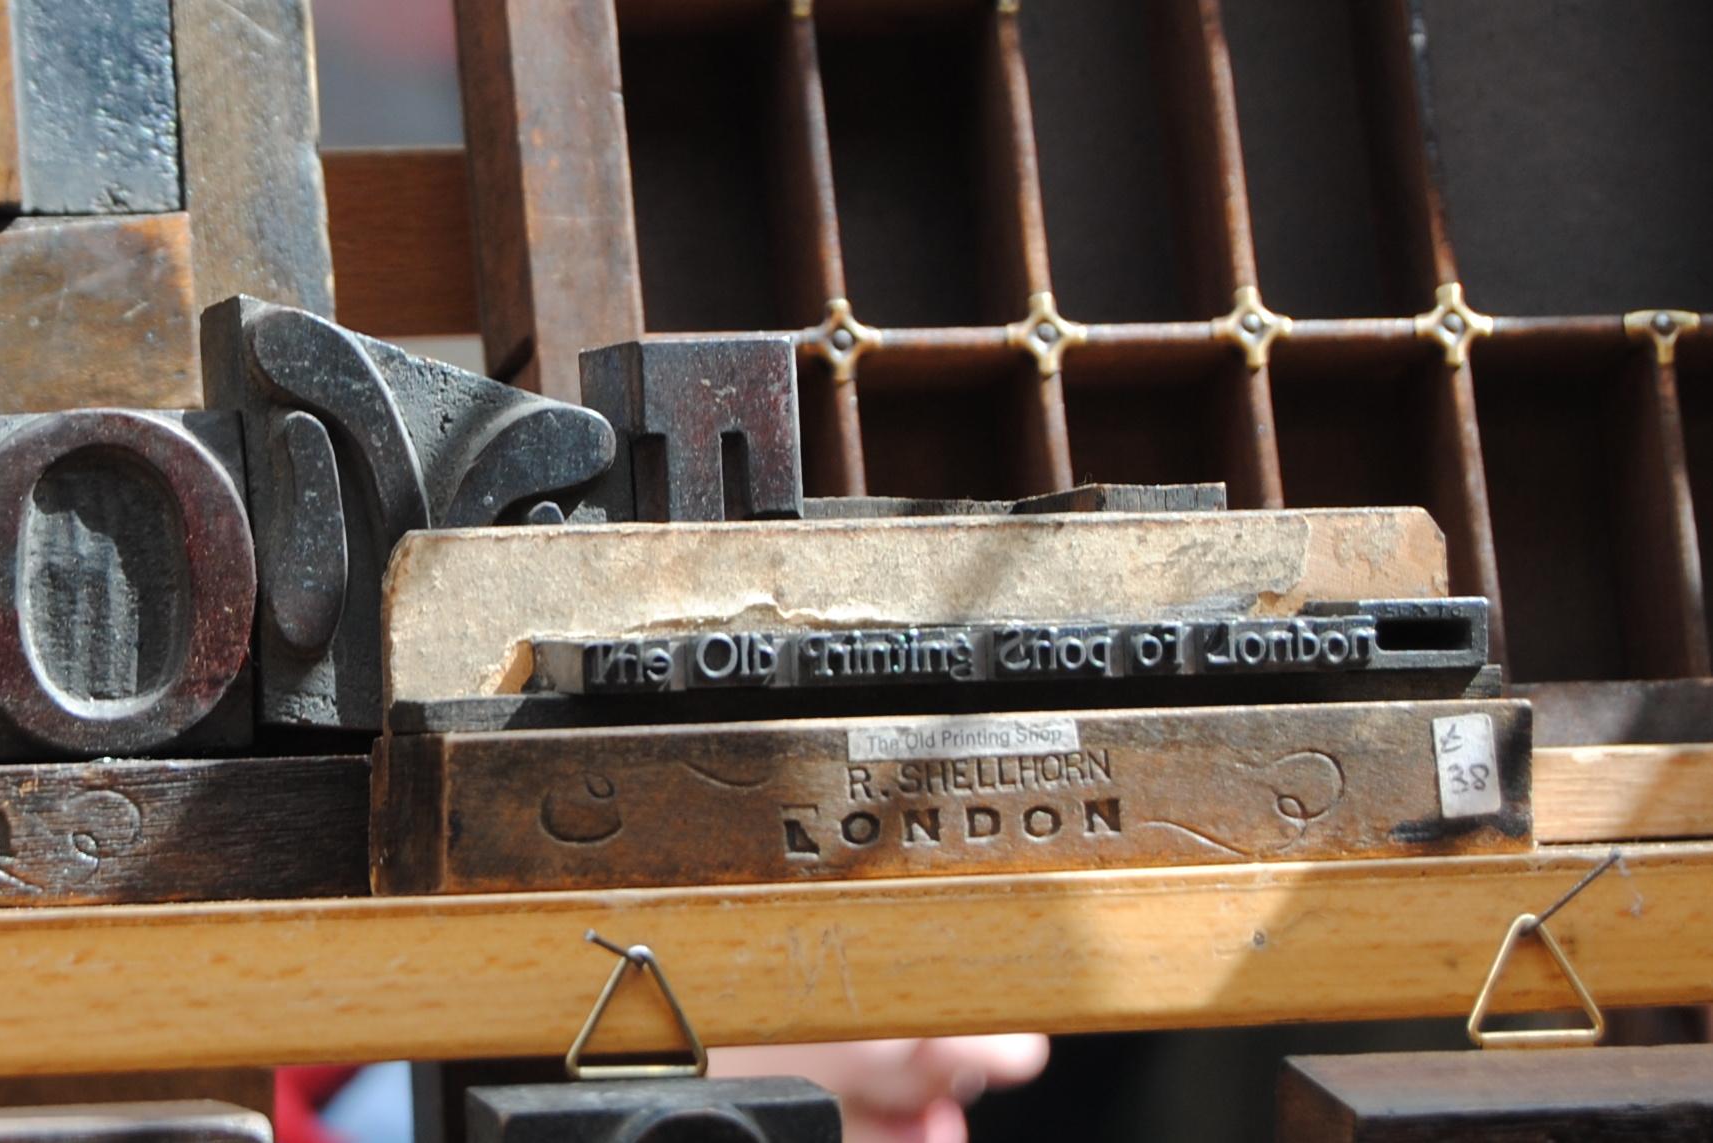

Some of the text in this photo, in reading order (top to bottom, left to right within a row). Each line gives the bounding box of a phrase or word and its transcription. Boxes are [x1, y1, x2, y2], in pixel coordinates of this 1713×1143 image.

[867, 722, 1063, 754] The Old Printing Shop
[846, 749, 1114, 803] R. SHELLHORN
[1447, 763, 1491, 795] 38
